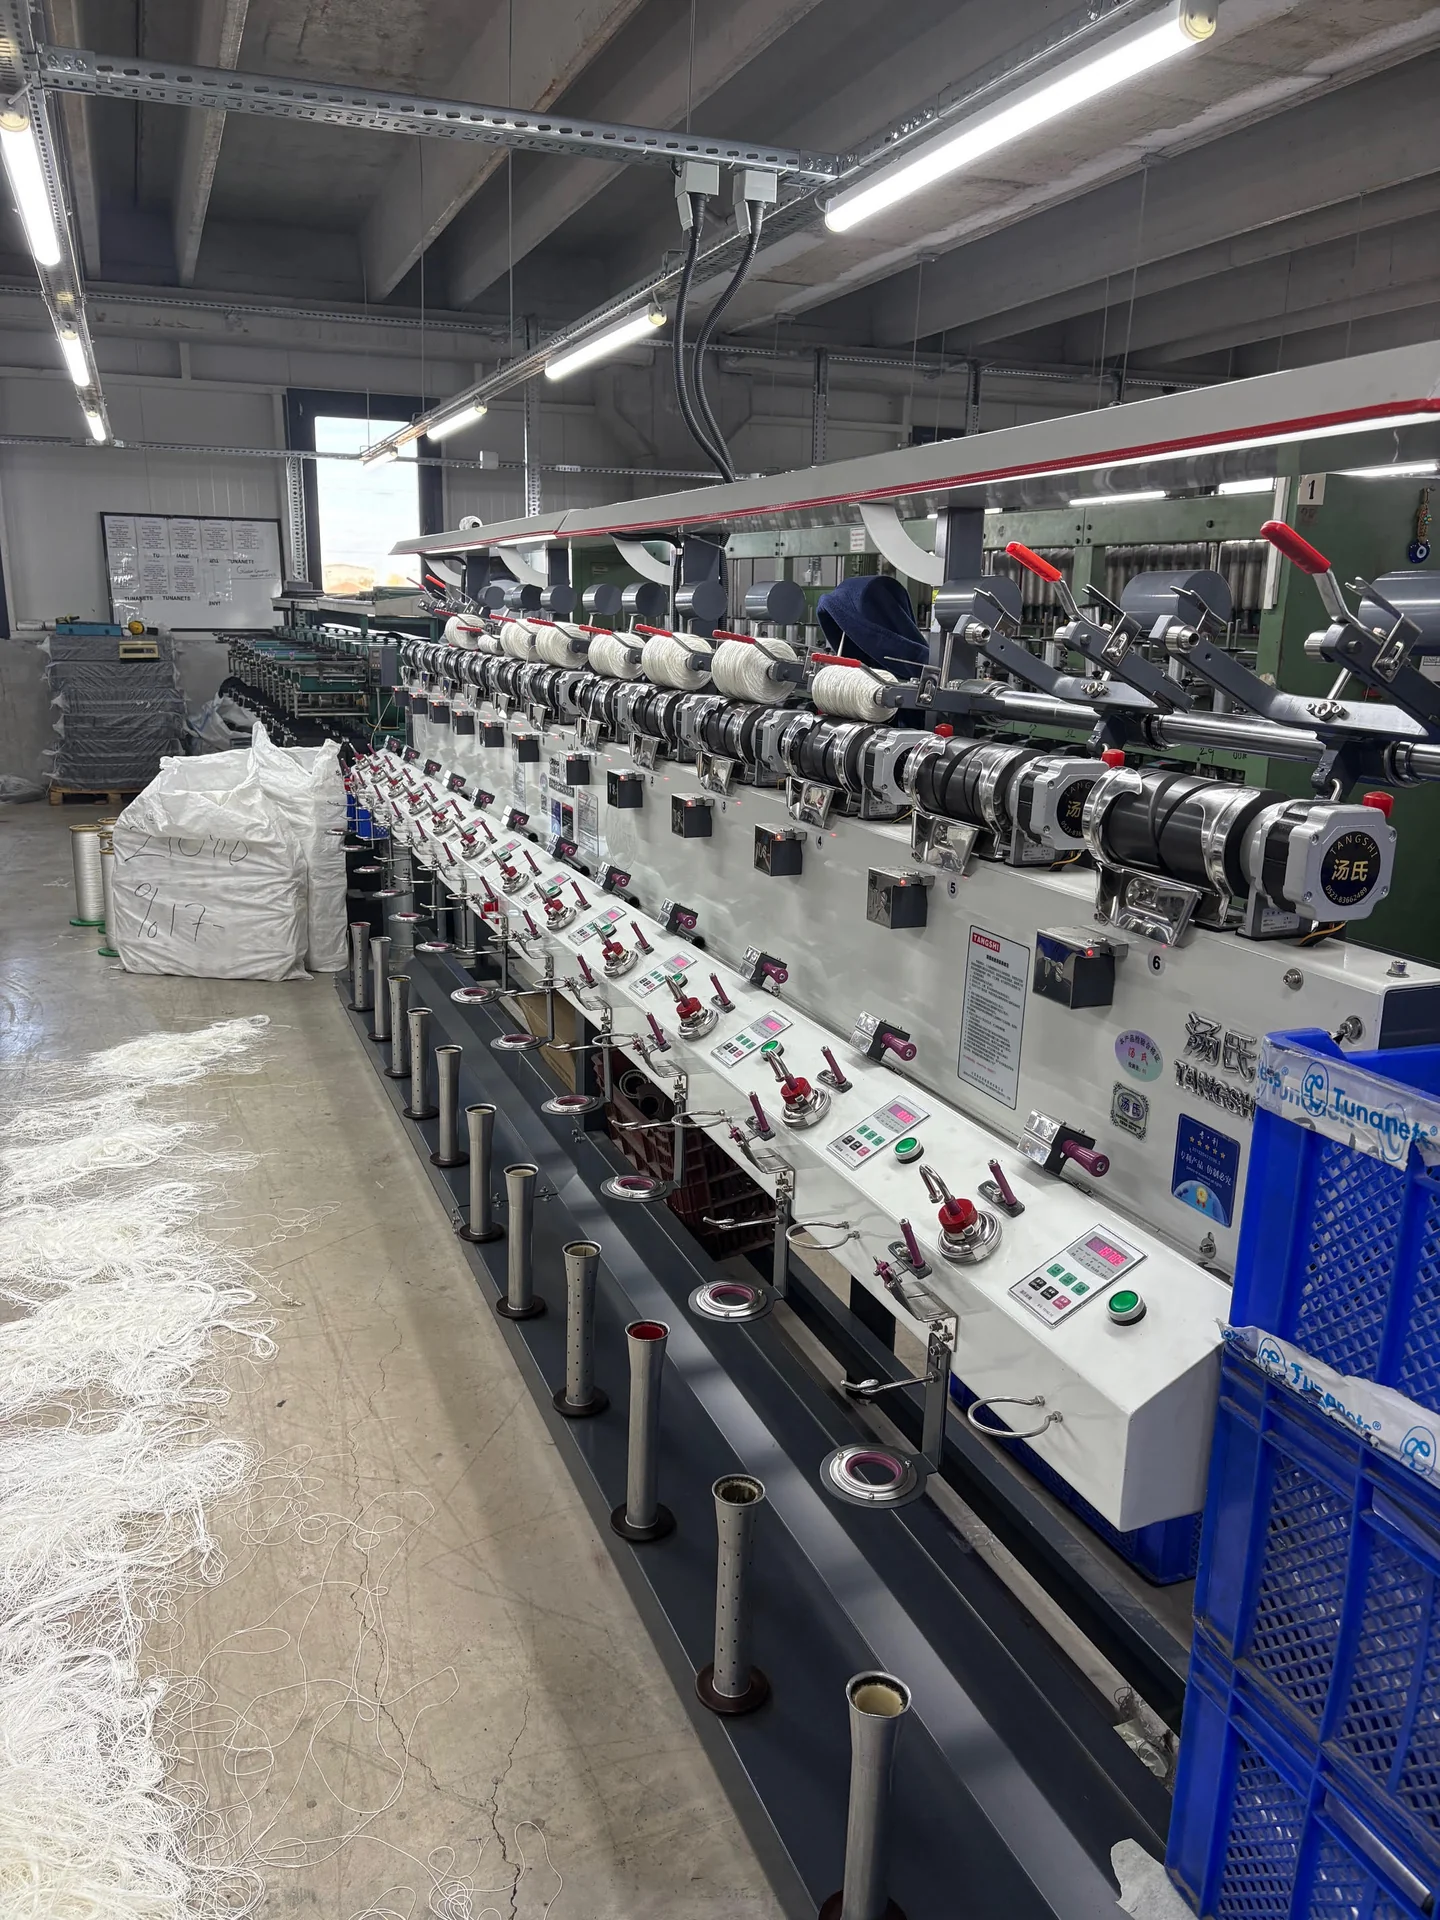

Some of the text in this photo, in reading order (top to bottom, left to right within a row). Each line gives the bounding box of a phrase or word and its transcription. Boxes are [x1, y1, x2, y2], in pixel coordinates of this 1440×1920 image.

[1308, 479, 1316, 500] 1
[1064, 782, 1091, 797] TANG
[1066, 800, 1082, 818] 汤
[1329, 834, 1379, 858] TANGSHI
[1331, 858, 1369, 881] 汤氏
[949, 881, 956, 894] 5
[972, 933, 1000, 952] TANGSHI
[1151, 954, 1162, 971] 6
[1184, 1011, 1257, 1083] 汤氏
[1173, 1059, 1255, 1122] TANGSH
[1120, 1096, 1142, 1117] 汤氏
